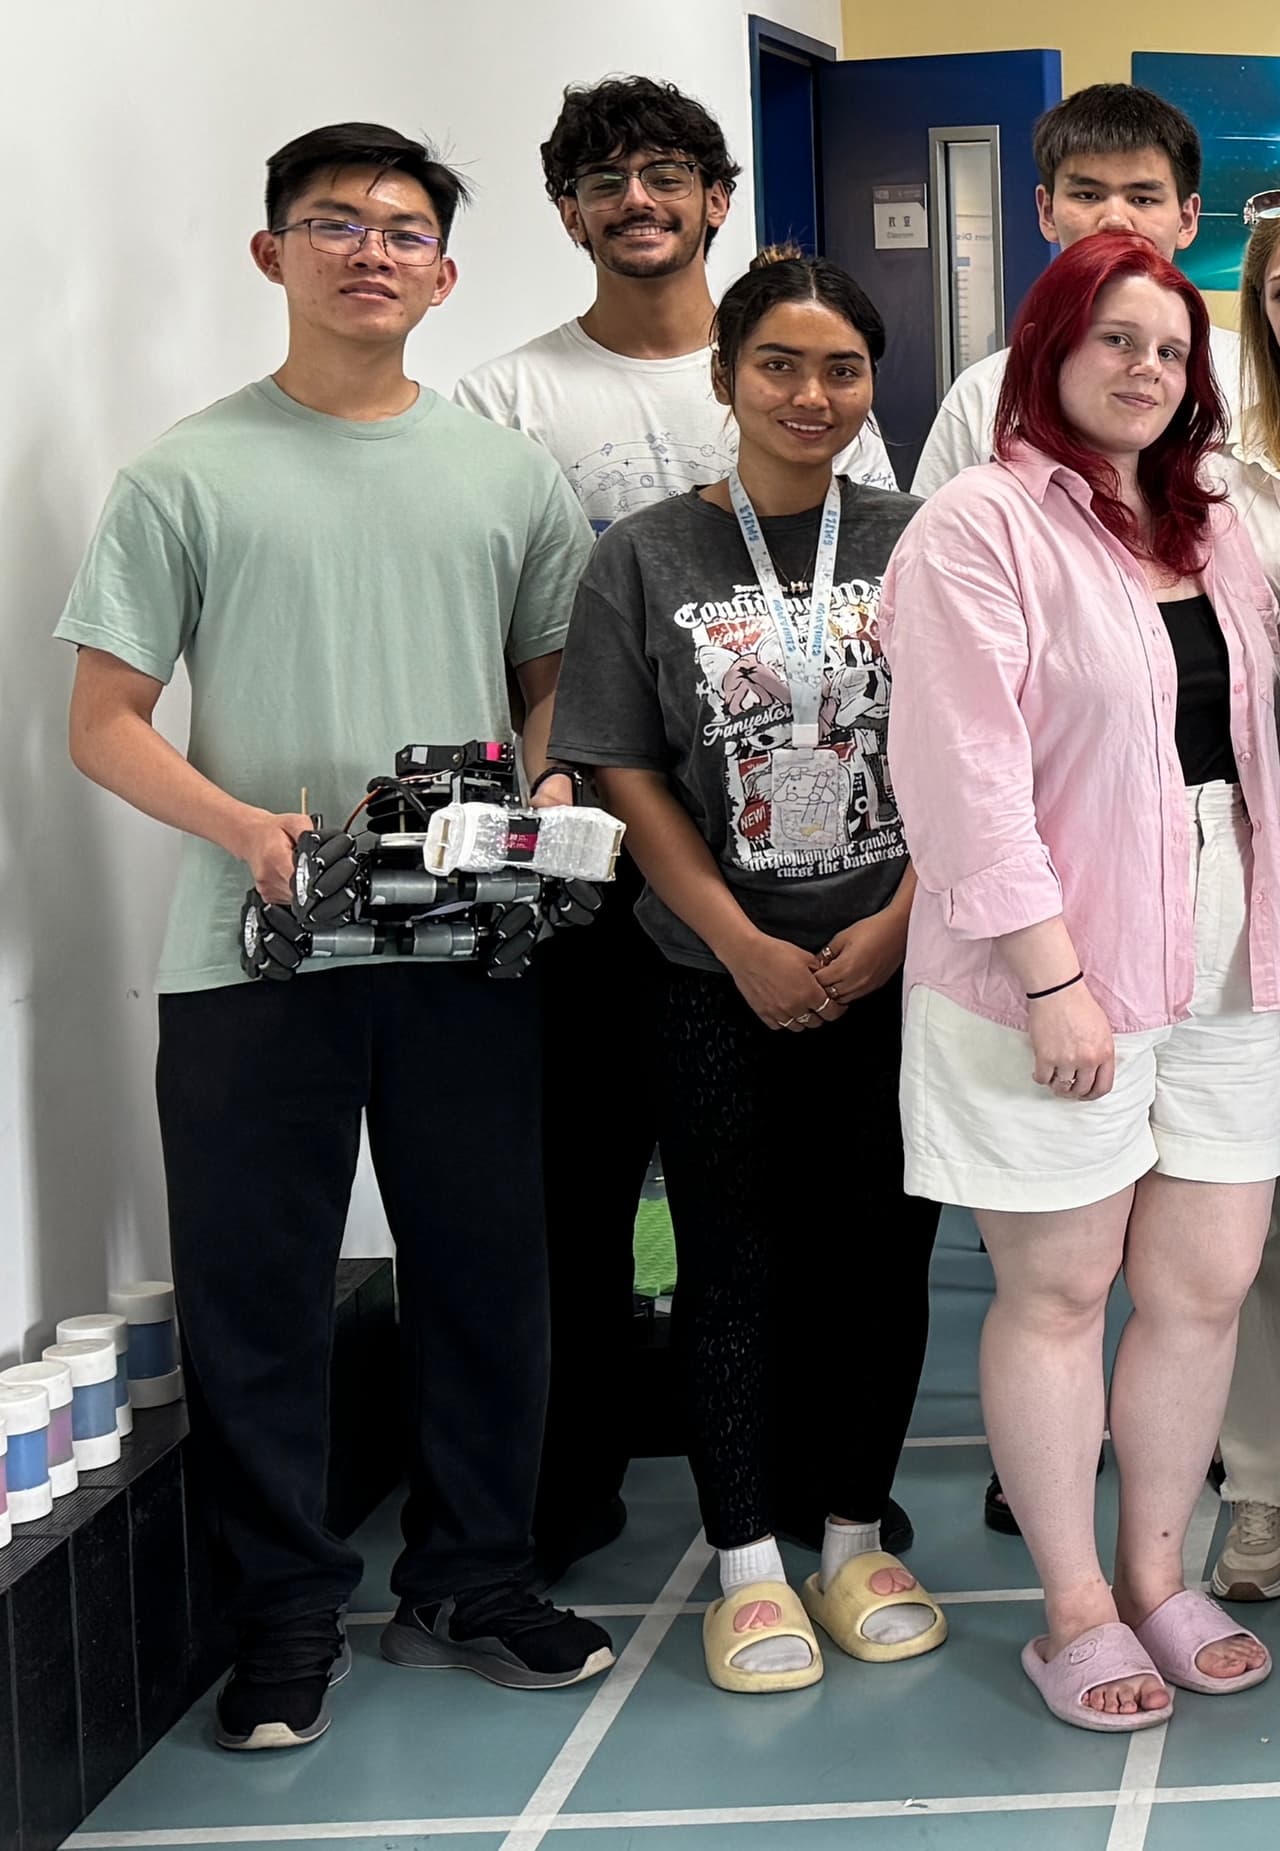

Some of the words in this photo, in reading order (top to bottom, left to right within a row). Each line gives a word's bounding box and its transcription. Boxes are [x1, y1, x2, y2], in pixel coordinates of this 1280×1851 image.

[859, 829, 897, 852] candle
[777, 864, 814, 878] curse
[818, 860, 840, 875] the
[842, 843, 909, 869] darkness.
